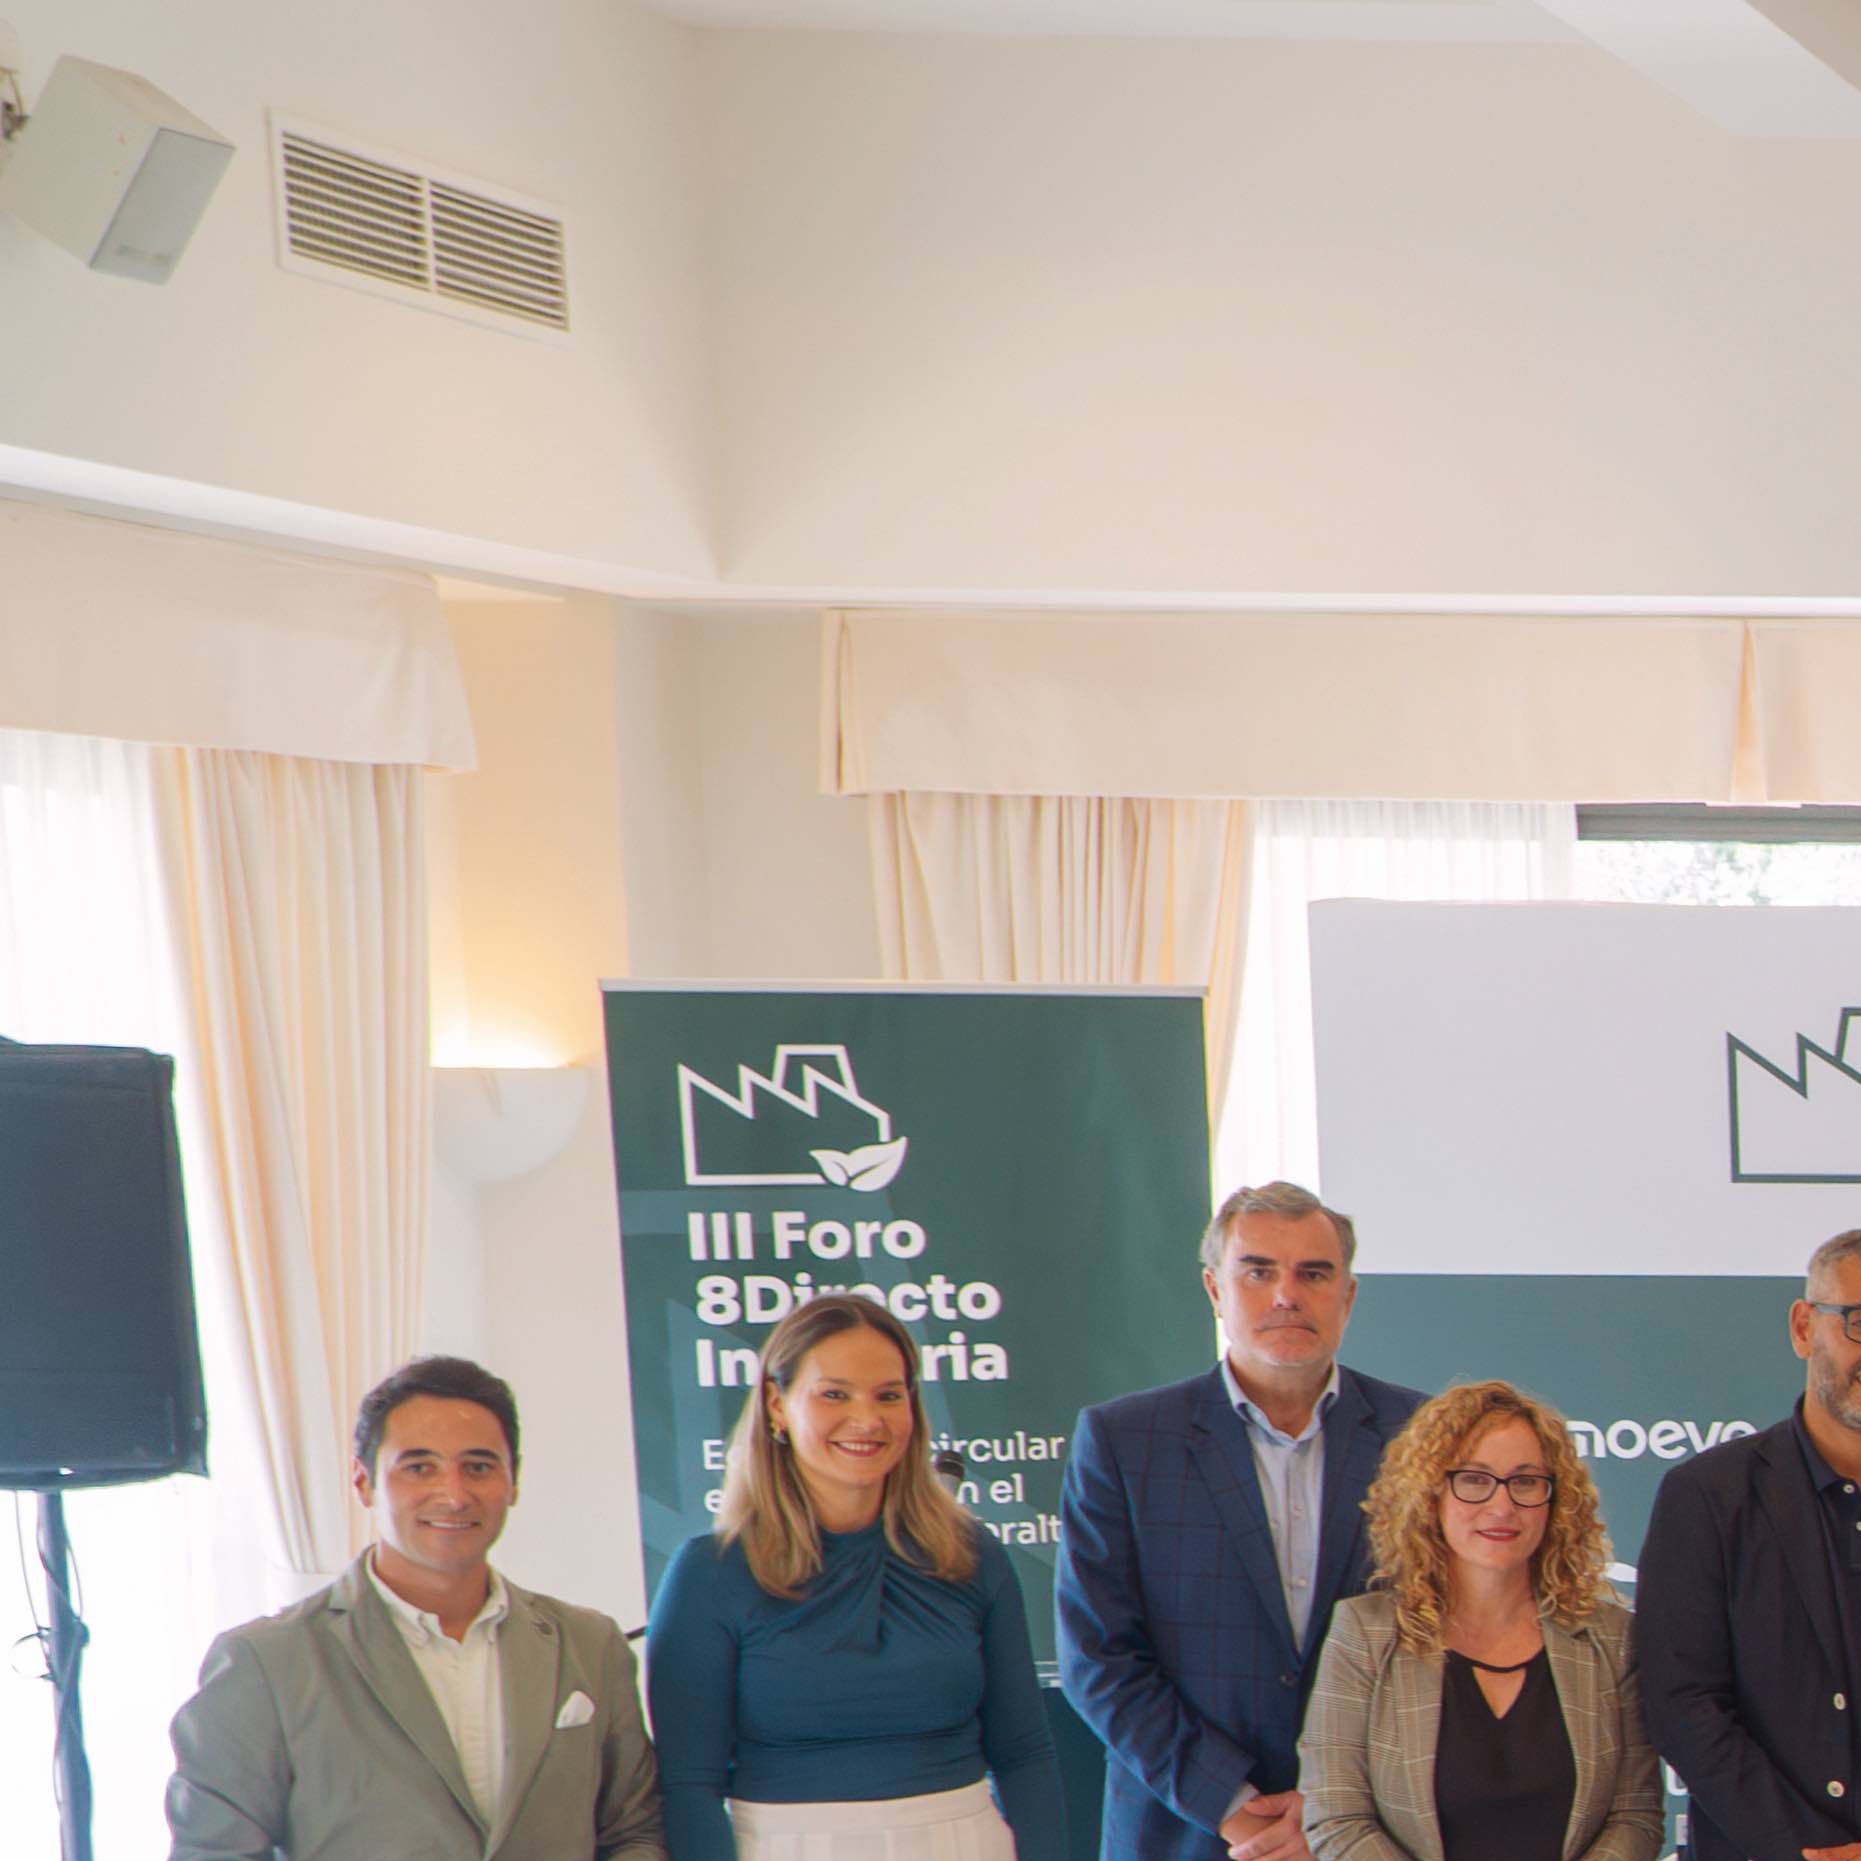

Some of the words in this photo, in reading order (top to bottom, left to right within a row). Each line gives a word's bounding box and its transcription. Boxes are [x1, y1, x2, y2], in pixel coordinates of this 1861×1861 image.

[688, 1212, 755, 1262] III
[772, 1211, 927, 1261] Foro
[990, 1473, 1024, 1504] el
